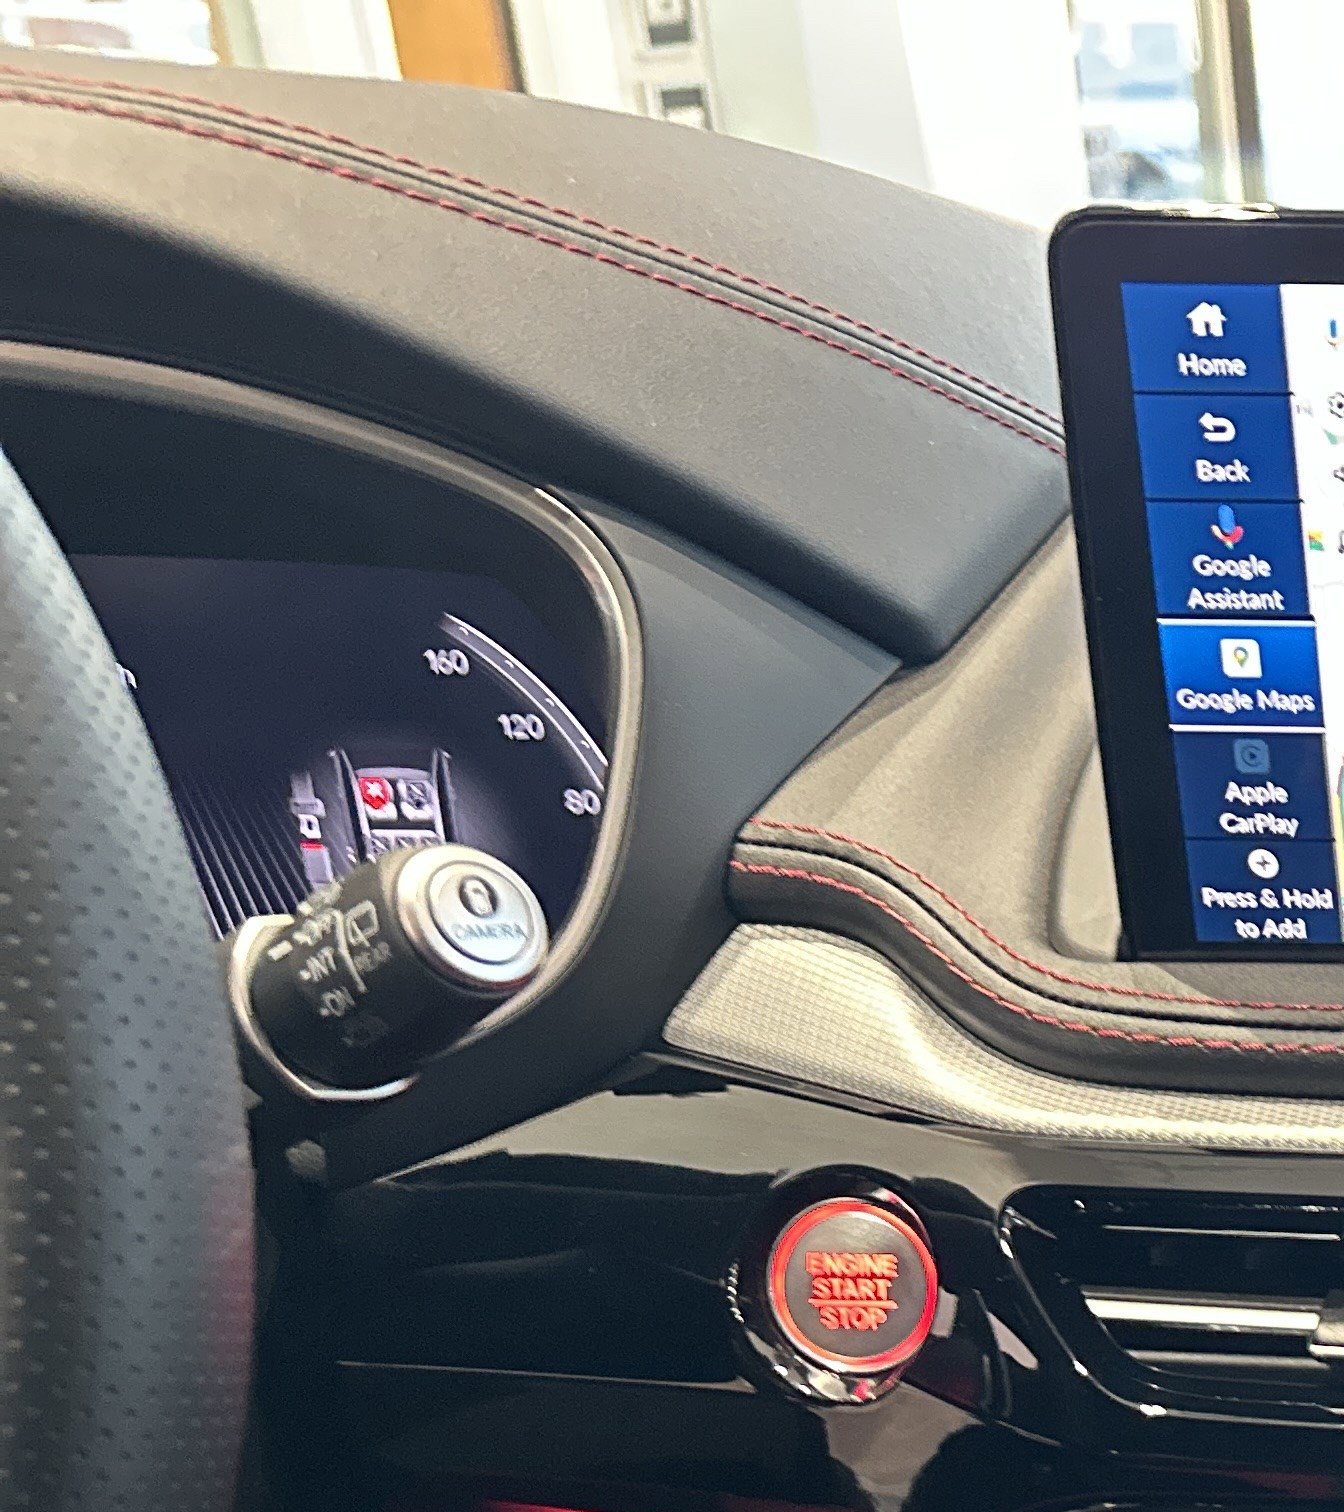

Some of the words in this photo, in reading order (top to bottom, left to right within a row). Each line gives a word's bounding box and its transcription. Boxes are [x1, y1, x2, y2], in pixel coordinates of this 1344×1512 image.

[1178, 353, 1247, 379] Home
[1196, 459, 1250, 485] Back
[1192, 556, 1271, 581] Google
[1187, 587, 1284, 611] Assistant
[423, 649, 470, 677] 160
[1176, 687, 1253, 713] Google
[1257, 688, 1316, 713] Maps
[498, 713, 546, 742] 120
[563, 788, 601, 816] 80
[1224, 781, 1289, 807] Apple
[1218, 812, 1298, 840] CarPlay
[1201, 887, 1258, 909] Press
[1262, 888, 1279, 909] &
[1282, 888, 1334, 910] Hold
[1235, 919, 1260, 939] to
[1263, 919, 1307, 940] Add
[804, 1252, 898, 1278] ENGINE
[812, 1277, 892, 1301] START
[819, 1306, 887, 1330] STOP
